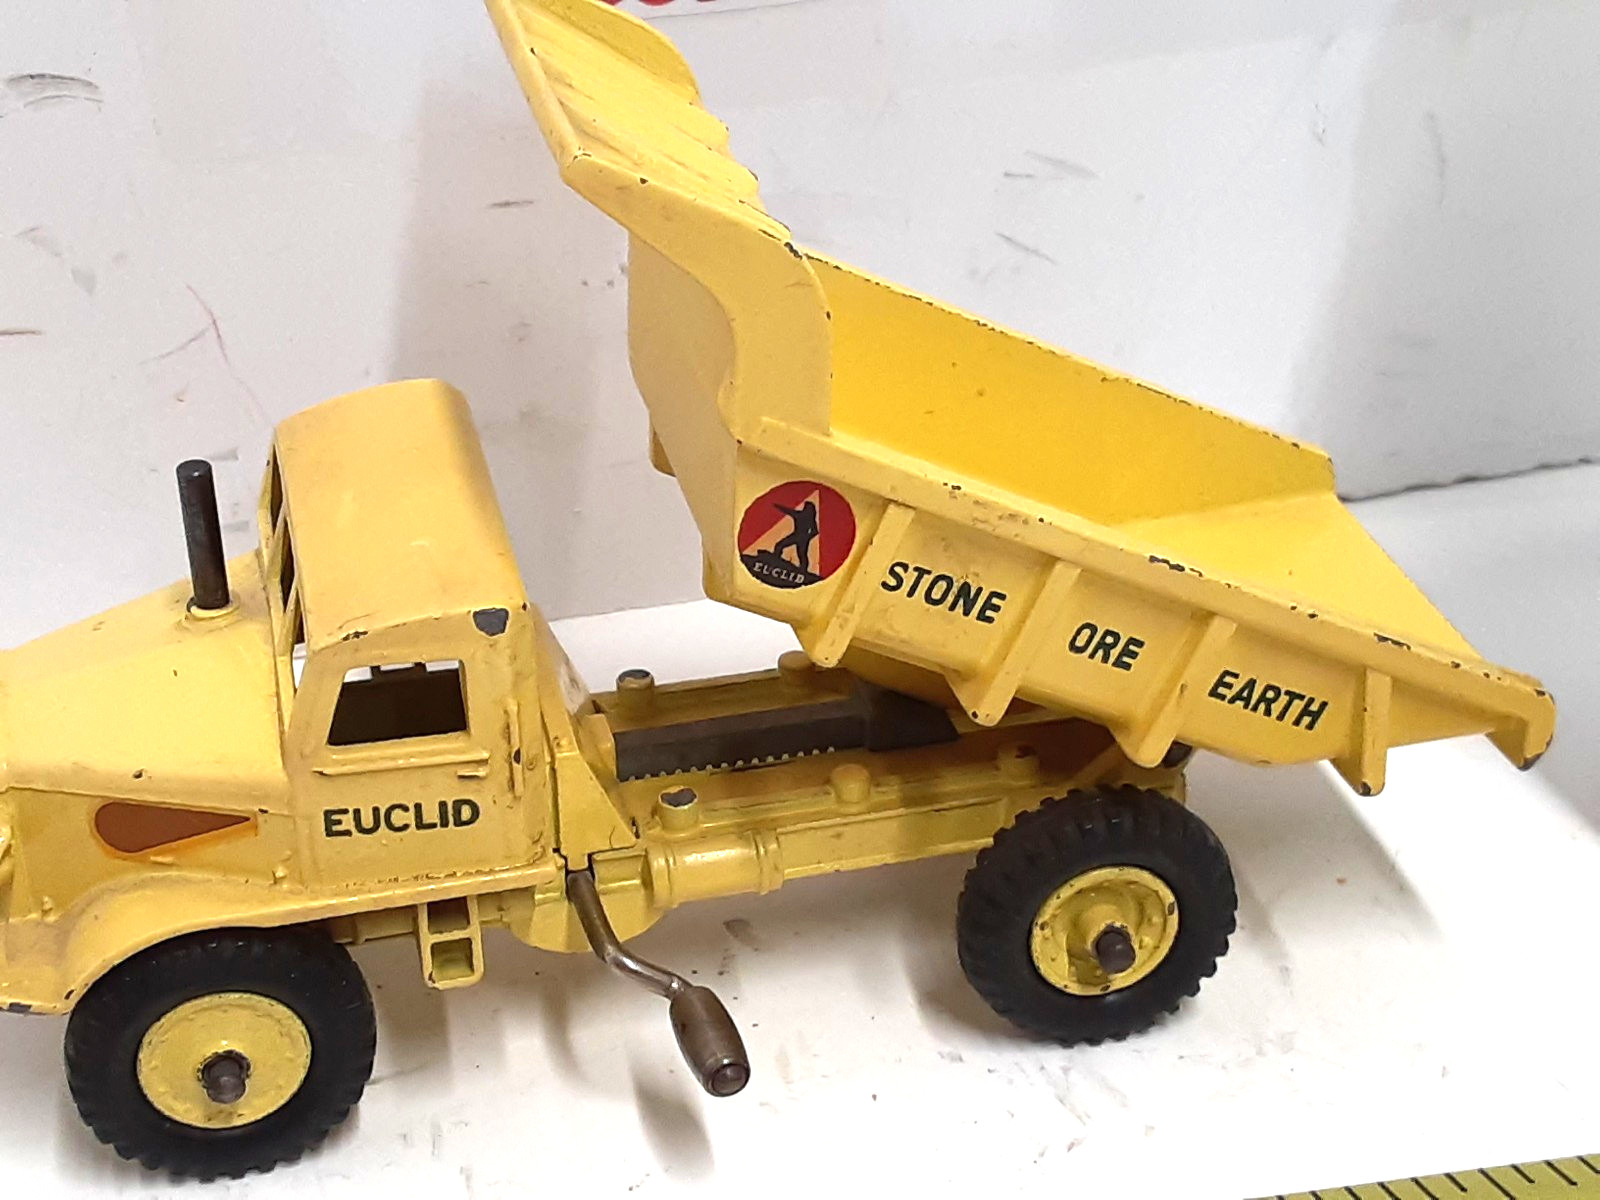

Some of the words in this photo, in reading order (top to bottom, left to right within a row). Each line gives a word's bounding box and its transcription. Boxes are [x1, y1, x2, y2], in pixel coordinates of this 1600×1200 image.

[753, 562, 805, 584] EUCLID
[880, 561, 1007, 624] STONE
[1067, 622, 1145, 672] ORE
[1207, 669, 1329, 731] EARTH
[323, 798, 481, 838] EUCLID
